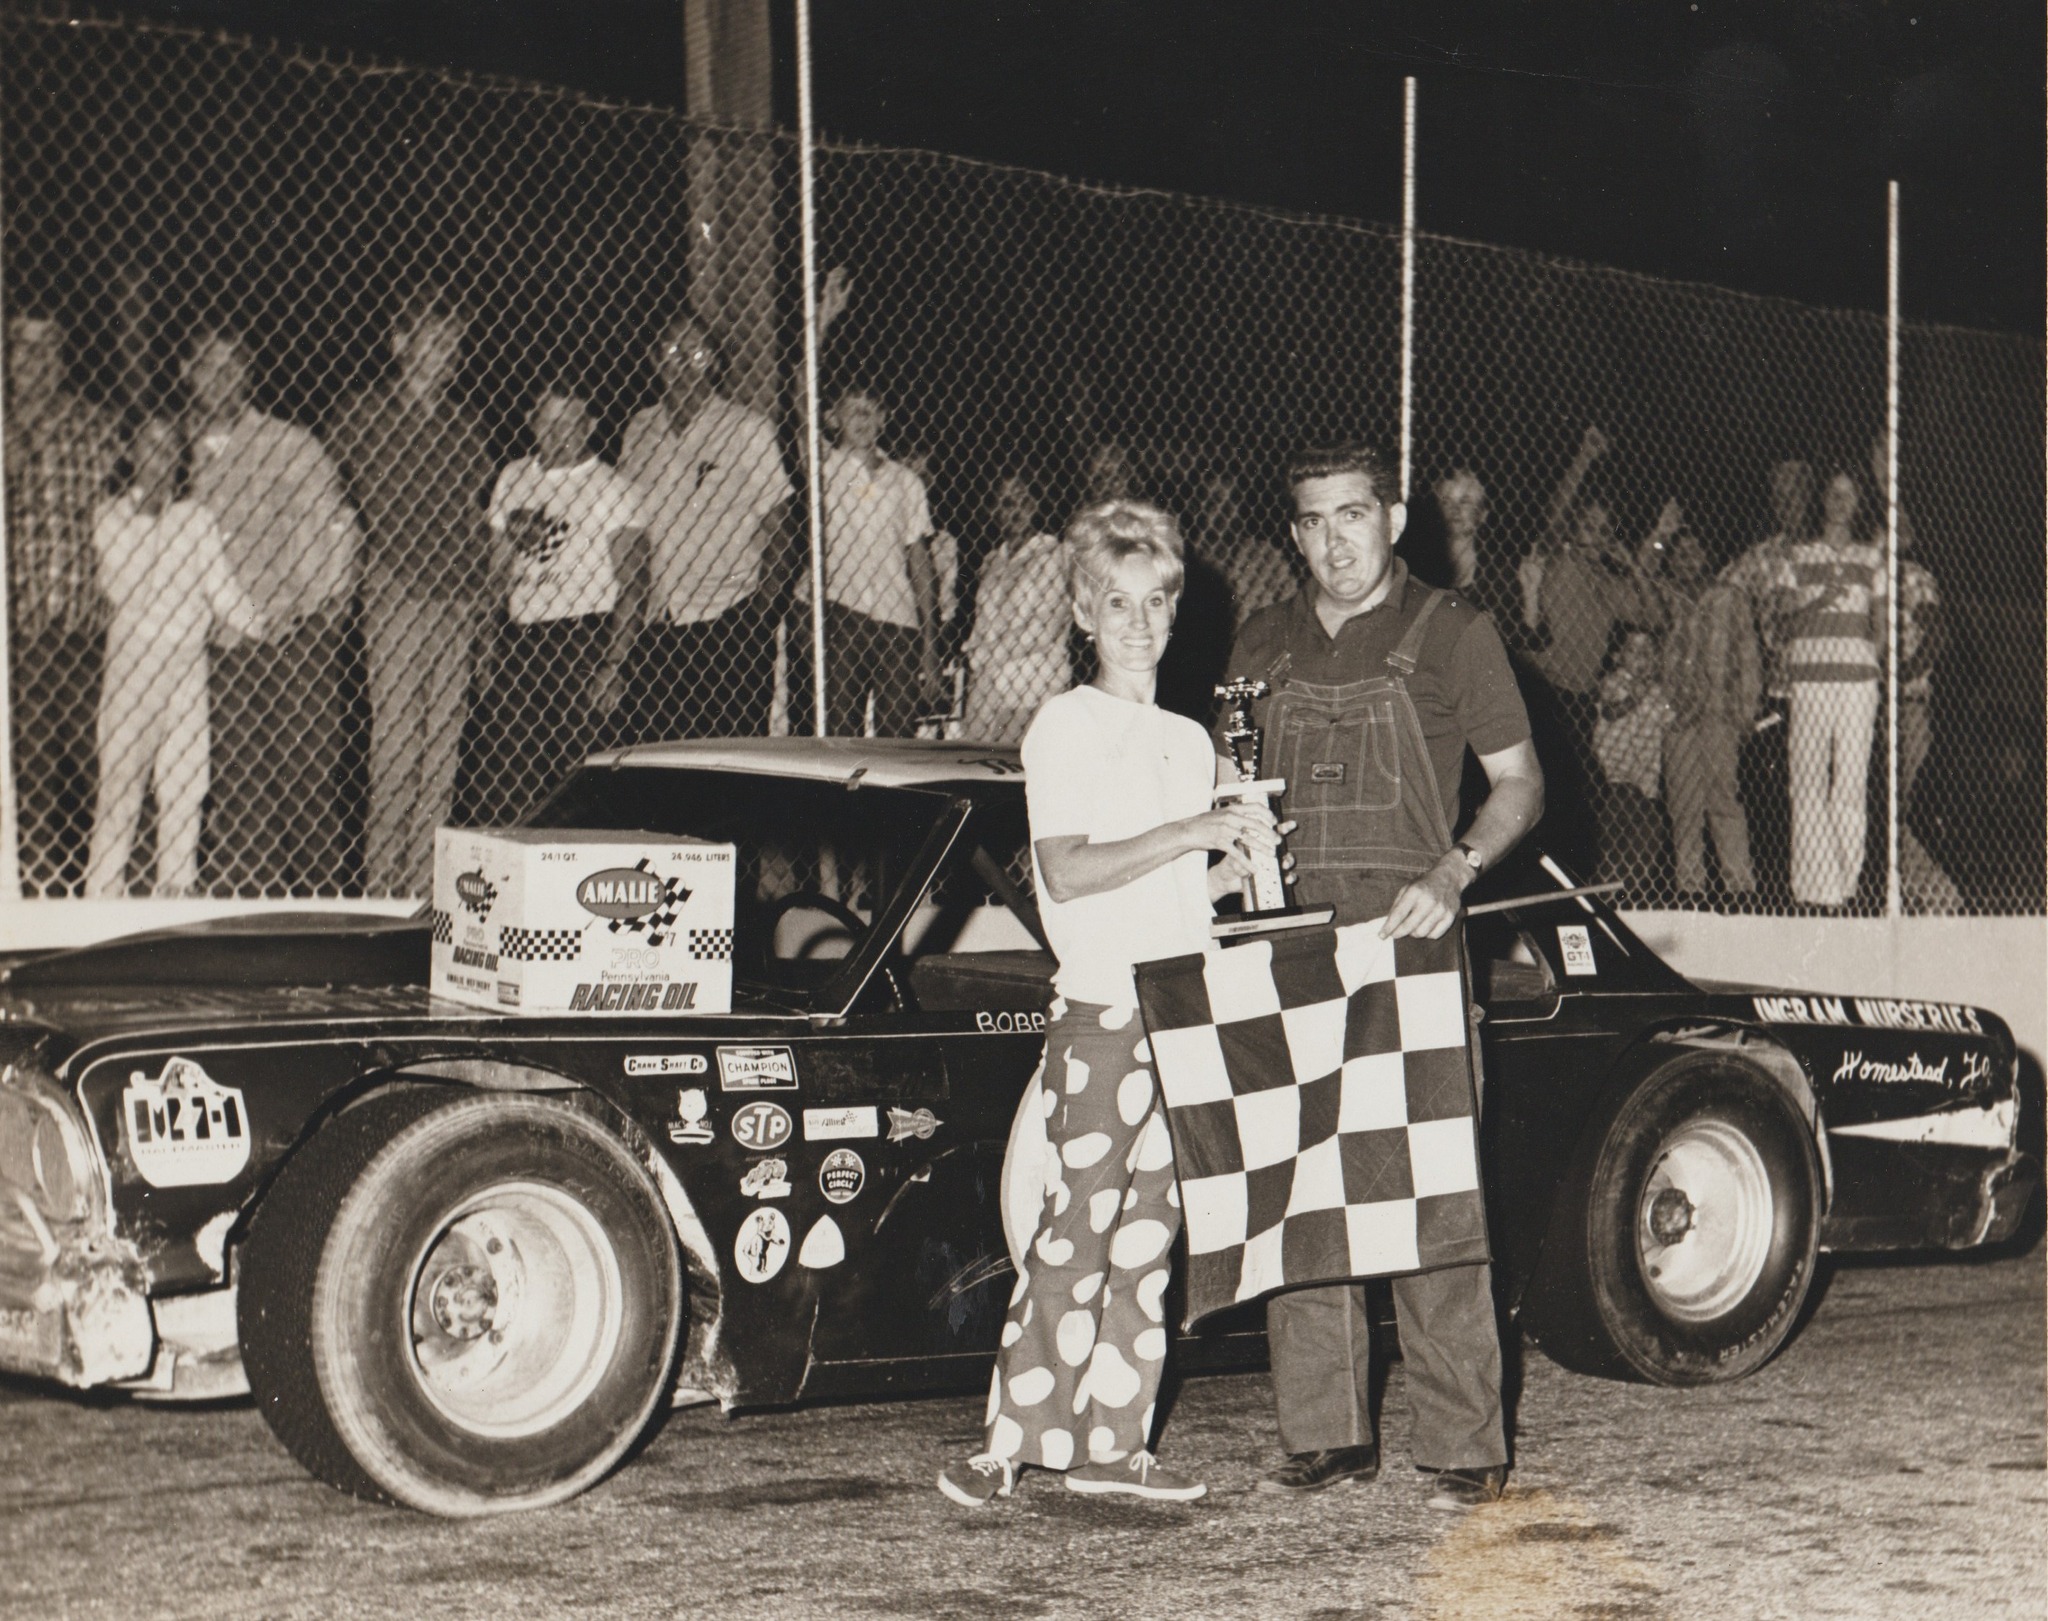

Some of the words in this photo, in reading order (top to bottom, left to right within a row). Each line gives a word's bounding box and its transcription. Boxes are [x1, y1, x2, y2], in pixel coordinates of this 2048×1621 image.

[706, 853, 730, 862] LITERS
[582, 880, 661, 904] AMALIE
[611, 948, 660, 969] PRO
[601, 970, 670, 982] Pennsylvania
[569, 983, 663, 1011] RACING
[661, 983, 698, 1011] OIL
[1752, 997, 1851, 1025] INGRAM
[1855, 998, 1983, 1035] NURSERIES
[728, 1062, 788, 1073] CHAMPION
[1833, 1050, 1953, 1089] Homestead,
[738, 1107, 786, 1144] STP
[826, 1170, 858, 1181] PERFECT
[828, 1179, 854, 1189] CIRCLE
